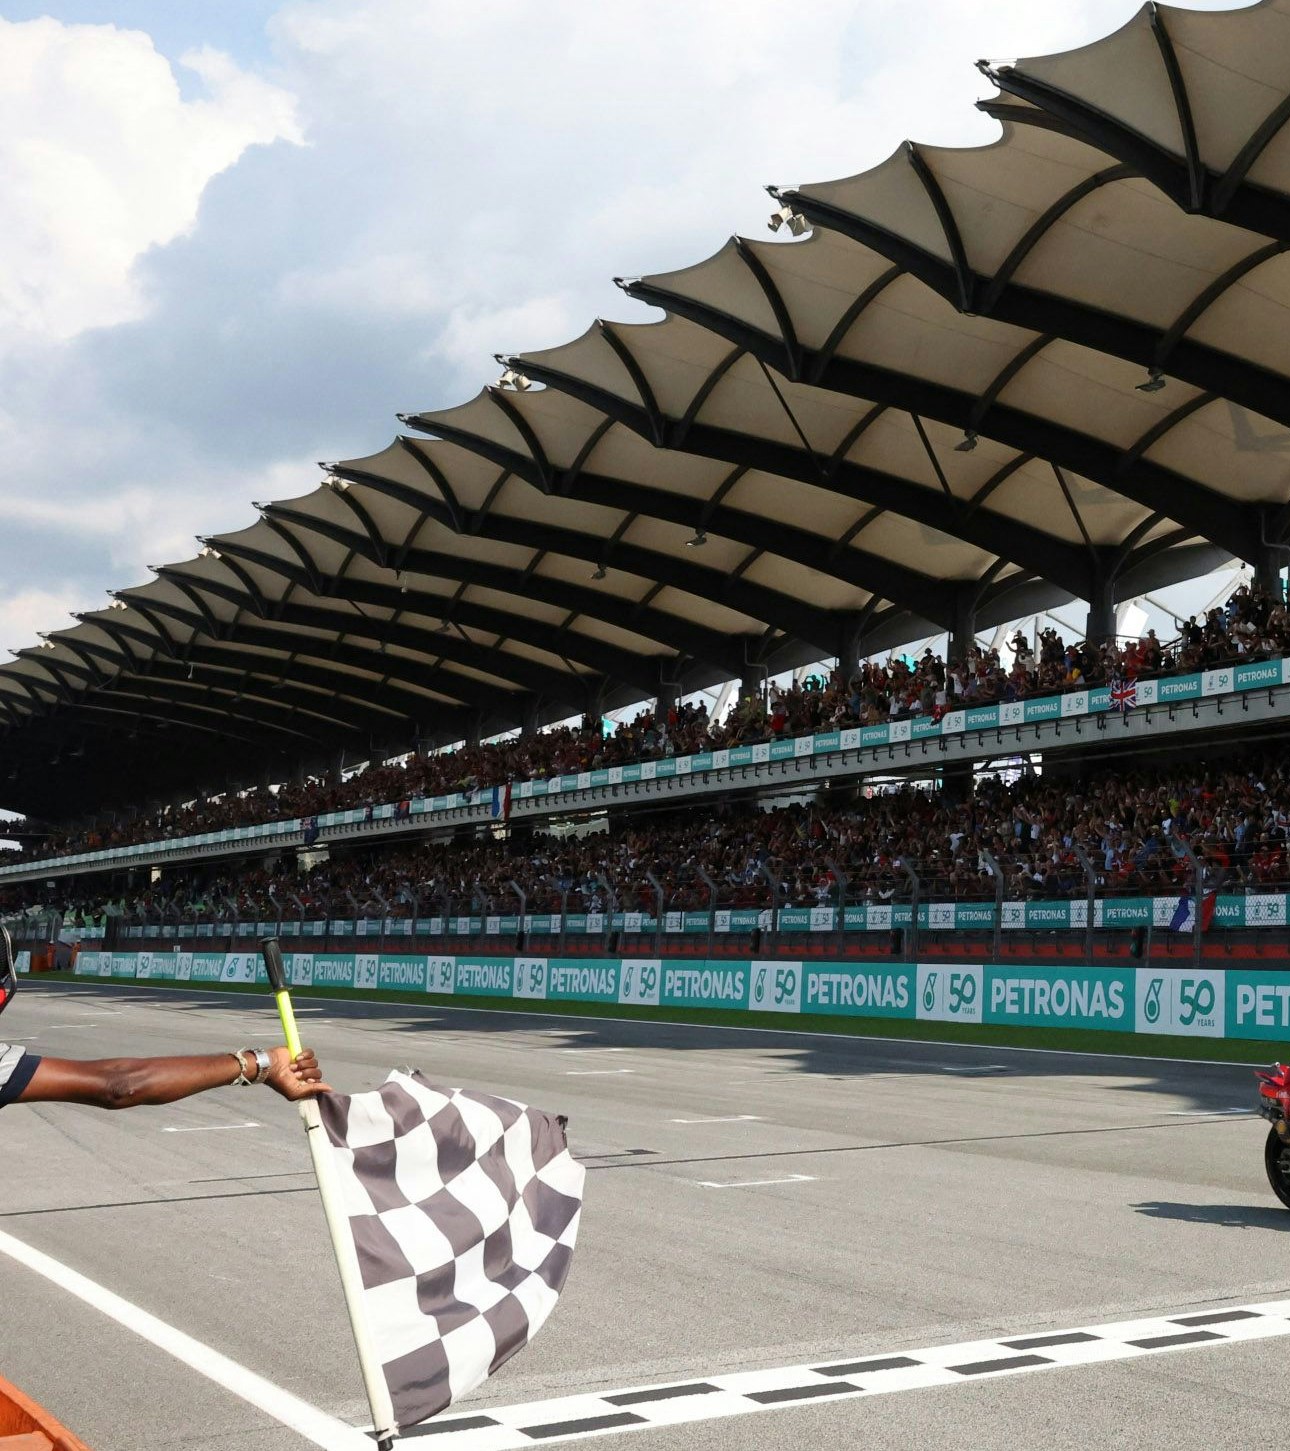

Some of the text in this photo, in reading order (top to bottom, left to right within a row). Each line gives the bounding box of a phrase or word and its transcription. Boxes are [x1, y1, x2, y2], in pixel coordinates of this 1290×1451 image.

[1238, 668, 1277, 683] PETRONAS
[1161, 681, 1197, 695] PETRONAS
[967, 712, 996, 724] PETRONAS
[1027, 703, 1058, 715] PETRONAS
[863, 730, 887, 741] PETRONAS
[958, 910, 991, 921] PETRONAS
[1029, 910, 1065, 920] PETRONAS
[1107, 908, 1148, 919] PETRONAS
[315, 961, 352, 981] PETRONAS
[366, 960, 375, 982] 50
[380, 962, 423, 985] PETRONAS
[441, 962, 452, 984] 50
[457, 965, 510, 990] PETRONAS
[530, 965, 544, 992] 50
[550, 968, 615, 995] PETRONAS
[640, 967, 656, 998] 50
[665, 970, 744, 999] PETRONAS
[775, 969, 796, 1004] 50
[808, 973, 908, 1008] PETRONAS
[950, 973, 976, 1013] 50
[991, 979, 1125, 1019] PETRONAS
[1179, 980, 1215, 1025] 50
[1197, 1019, 1215, 1027] YEARS
